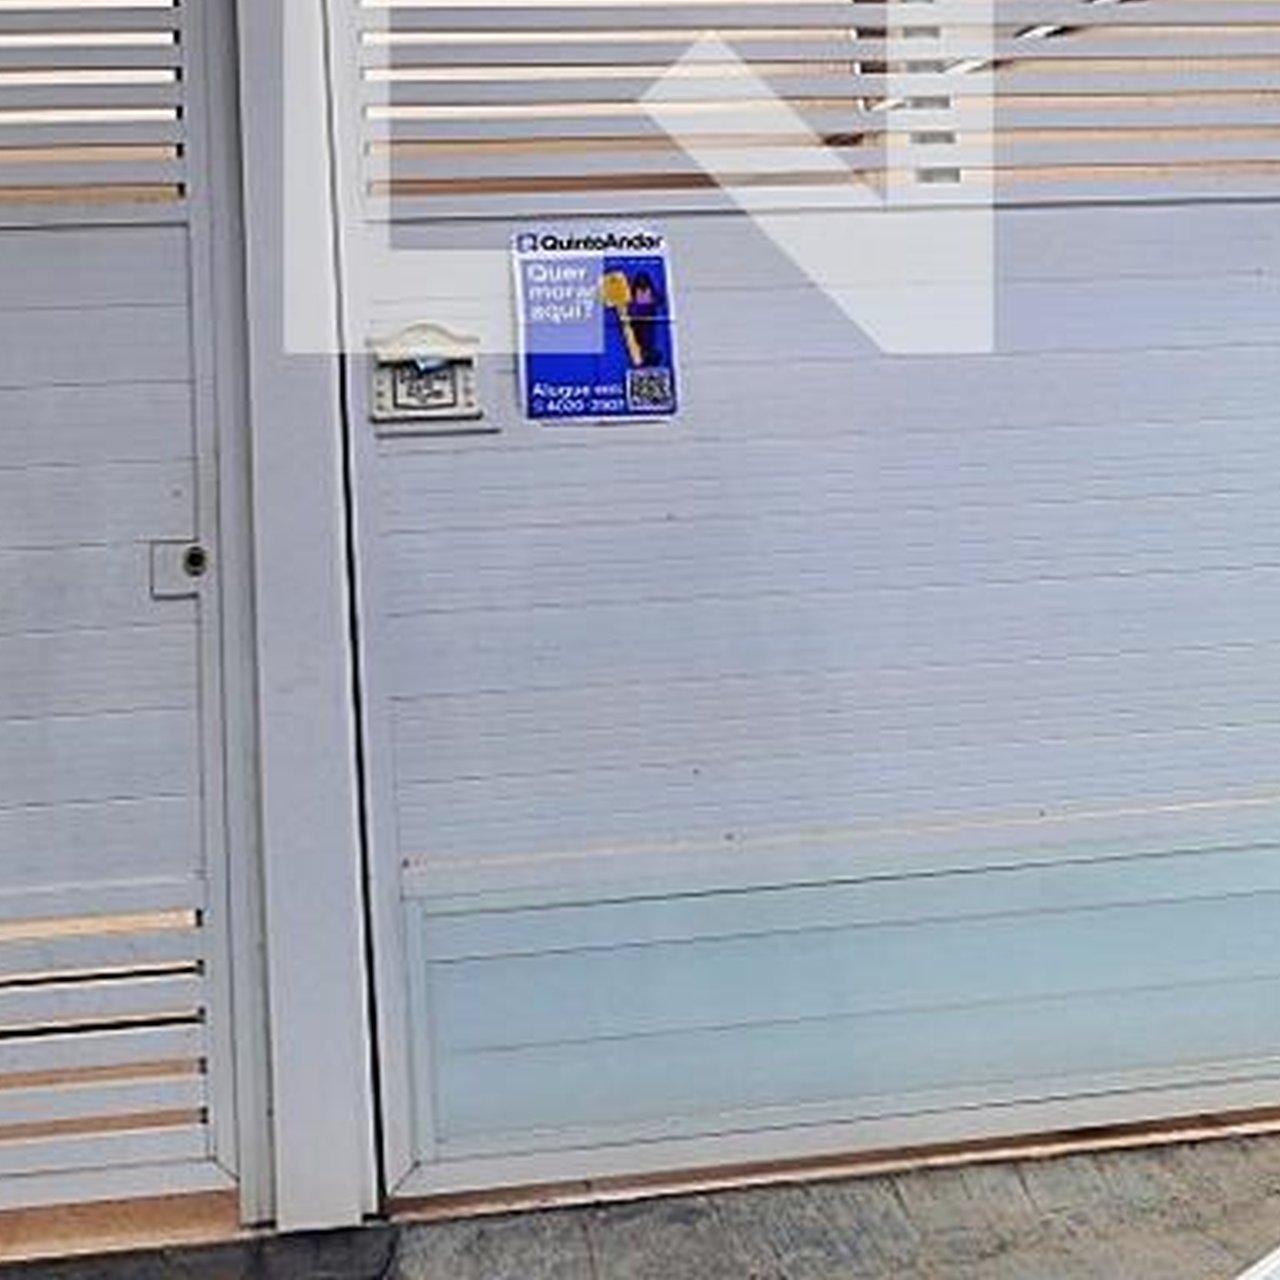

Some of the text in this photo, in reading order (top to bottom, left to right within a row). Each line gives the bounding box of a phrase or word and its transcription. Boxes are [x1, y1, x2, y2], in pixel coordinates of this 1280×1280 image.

[540, 232, 664, 251] QuintoAndar
[527, 264, 588, 284] Quer
[529, 286, 598, 302] morar
[532, 303, 593, 324] aqui?
